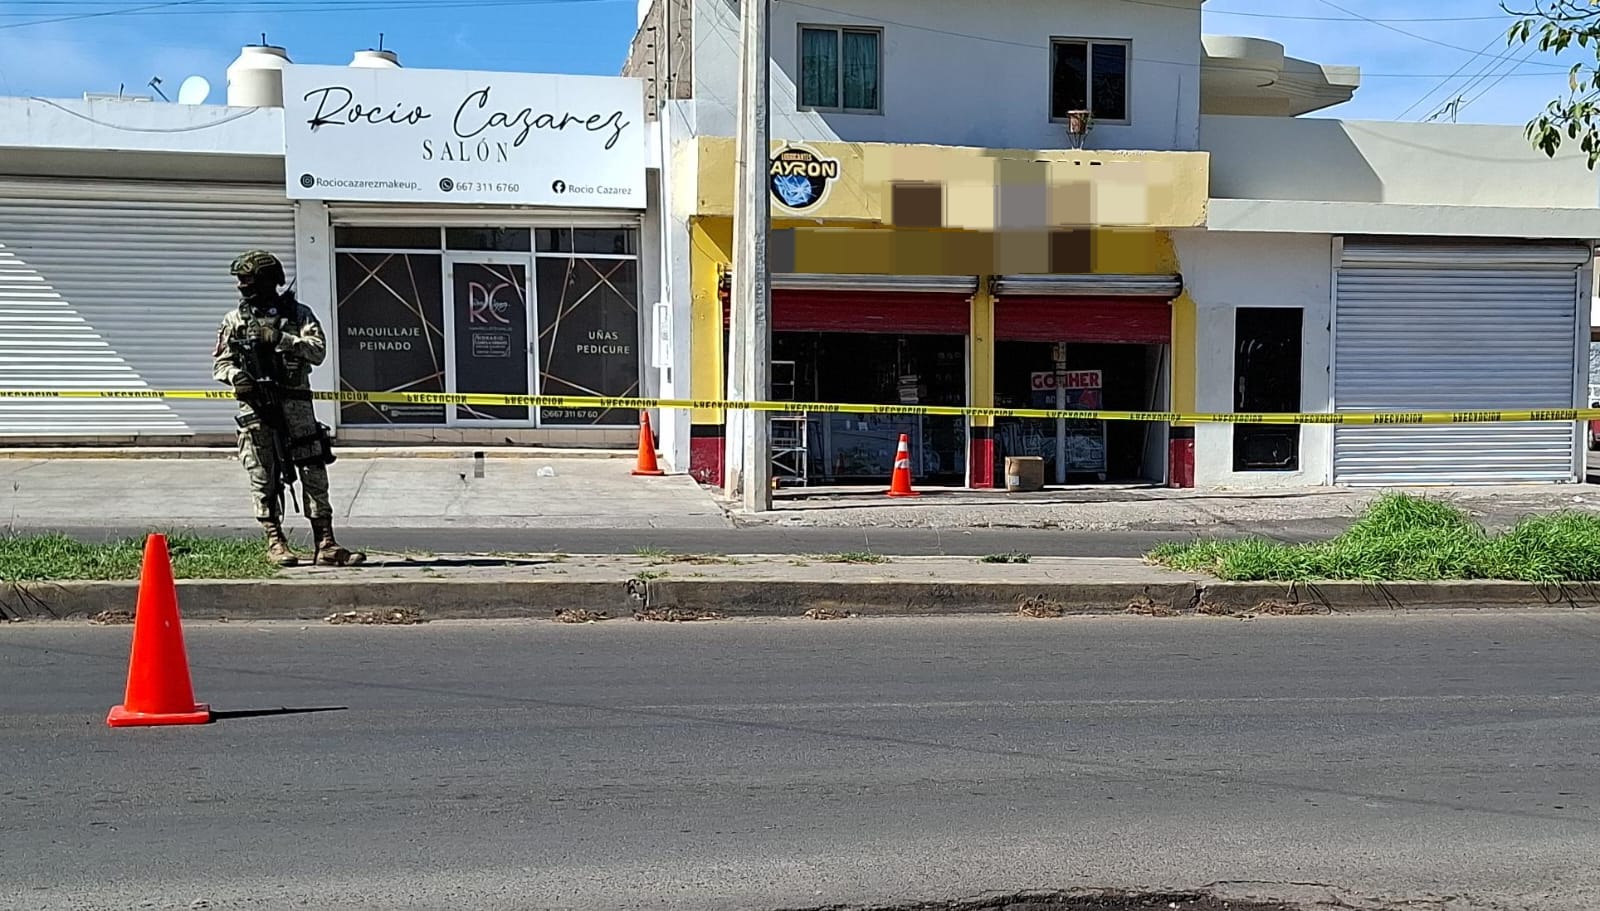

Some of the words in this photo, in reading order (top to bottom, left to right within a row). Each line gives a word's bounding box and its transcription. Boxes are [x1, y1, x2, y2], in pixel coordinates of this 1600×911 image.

[303, 86, 431, 132] Rocio
[453, 86, 631, 150] Cazarez
[422, 138, 510, 163] SALÓN
[769, 160, 836, 177] AYRON
[316, 177, 422, 191] Rociocazarezmakeup_
[456, 182, 472, 191] 667
[476, 182, 493, 192] 311
[496, 183, 519, 192] 6760
[568, 184, 594, 194] Rocio
[597, 185, 632, 195] Cazarez
[347, 327, 420, 337] MAQUILLAJE
[588, 329, 618, 340] UÑAS
[359, 341, 411, 351] PEINADO
[577, 344, 630, 354] PEDICURE
[1032, 372, 1099, 388] GOHER
[549, 410, 563, 418] 667
[564, 410, 576, 418] 311
